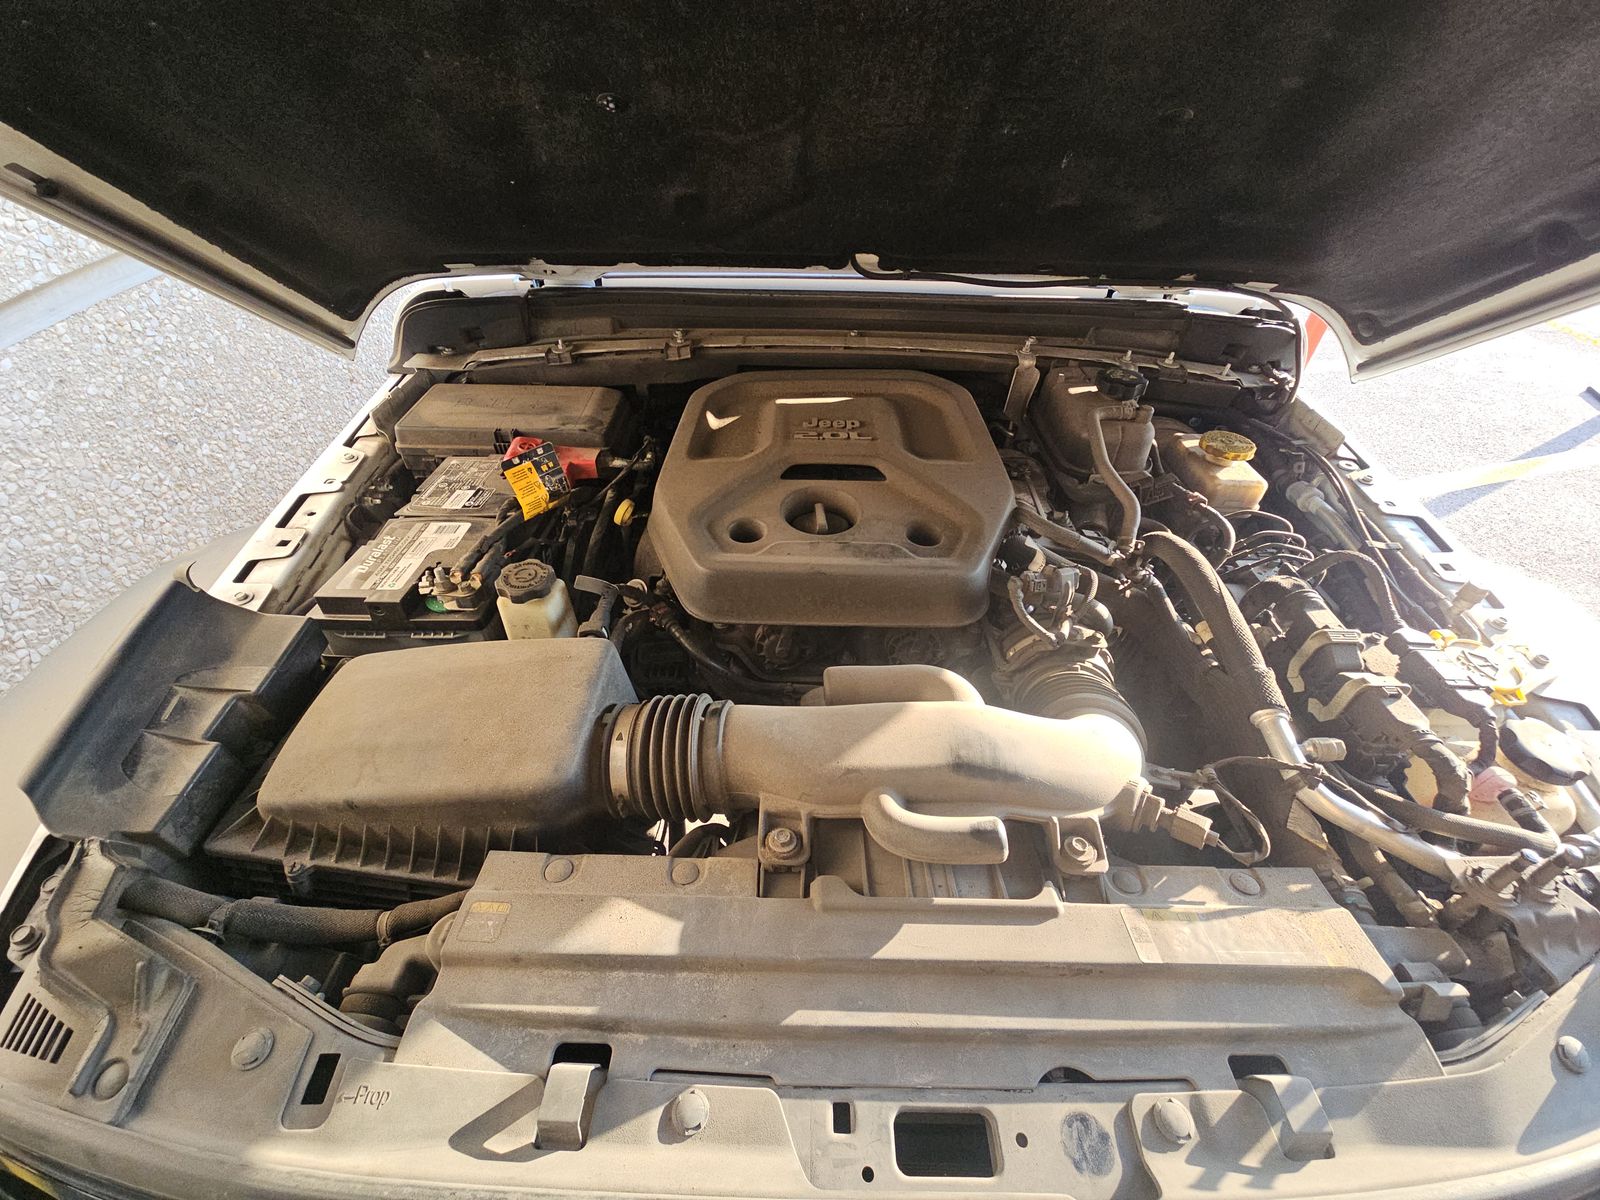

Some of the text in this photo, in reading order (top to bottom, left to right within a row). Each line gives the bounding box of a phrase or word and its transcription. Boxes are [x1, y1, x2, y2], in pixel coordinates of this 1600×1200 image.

[803, 417, 860, 430] Jeep
[794, 430, 873, 440] 2.0L
[357, 535, 396, 574] Duralast
[353, 1085, 390, 1111] Prop
